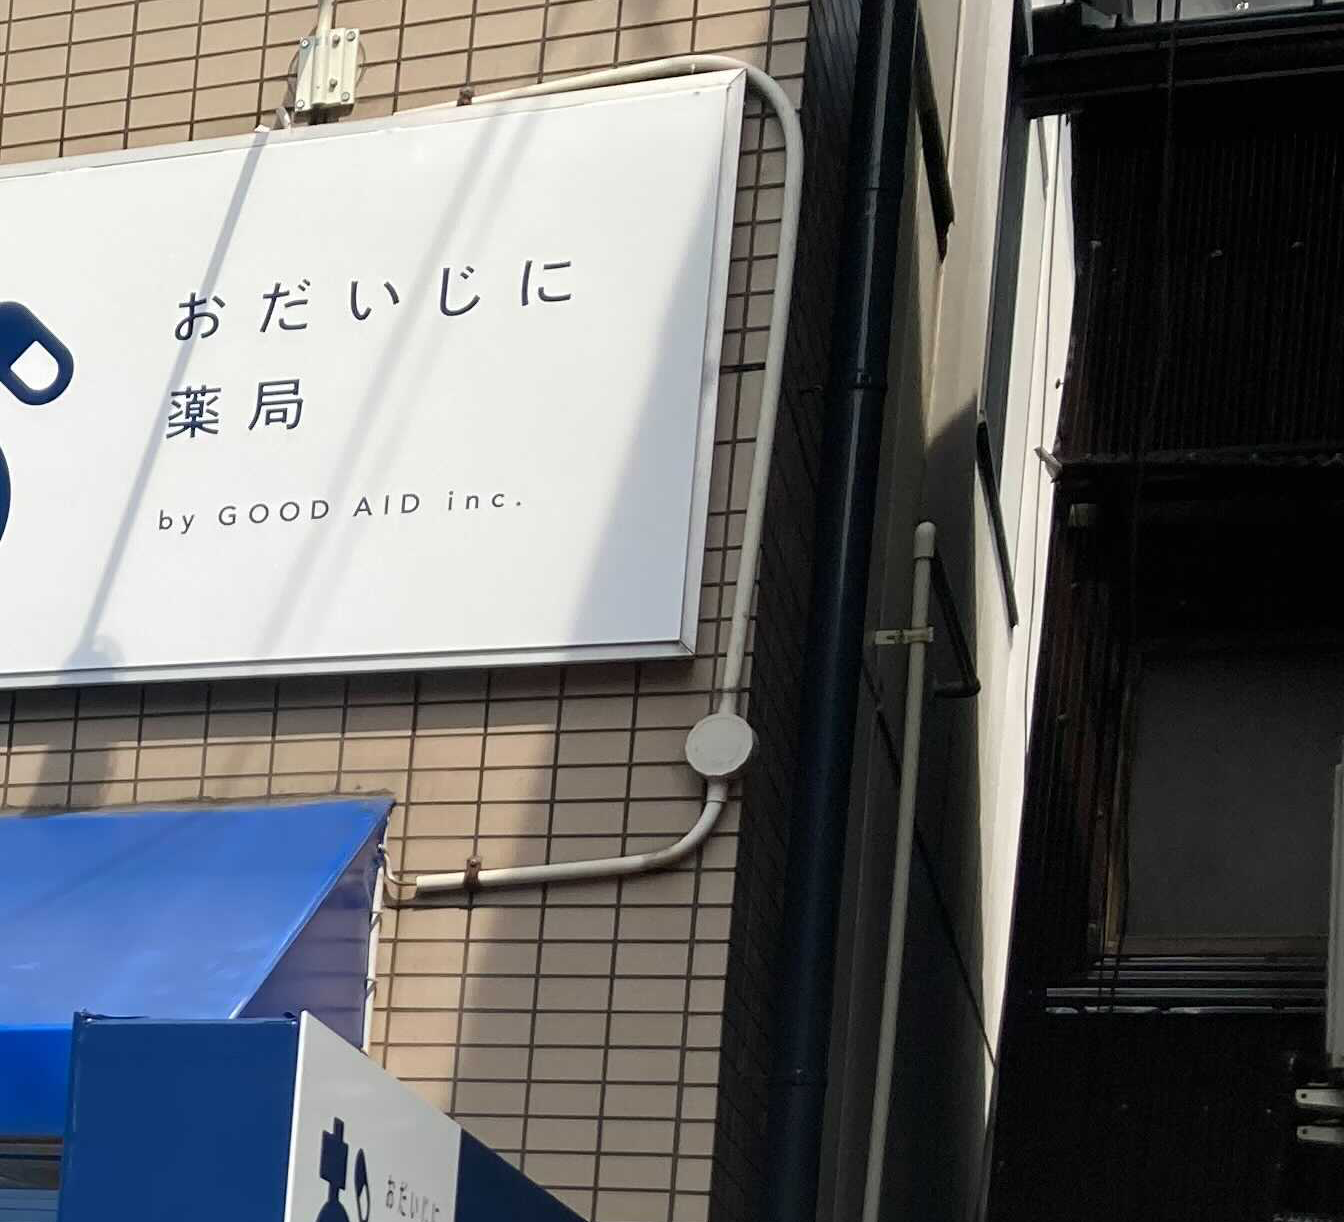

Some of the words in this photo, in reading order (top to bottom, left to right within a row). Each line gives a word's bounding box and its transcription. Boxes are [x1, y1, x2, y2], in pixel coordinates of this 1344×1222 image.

[174, 258, 575, 342] おだいじに
[165, 378, 305, 440] 薬局
[158, 508, 196, 535] by
[218, 498, 331, 528] GOOD
[353, 492, 422, 518] AID
[447, 489, 524, 512] inc.
